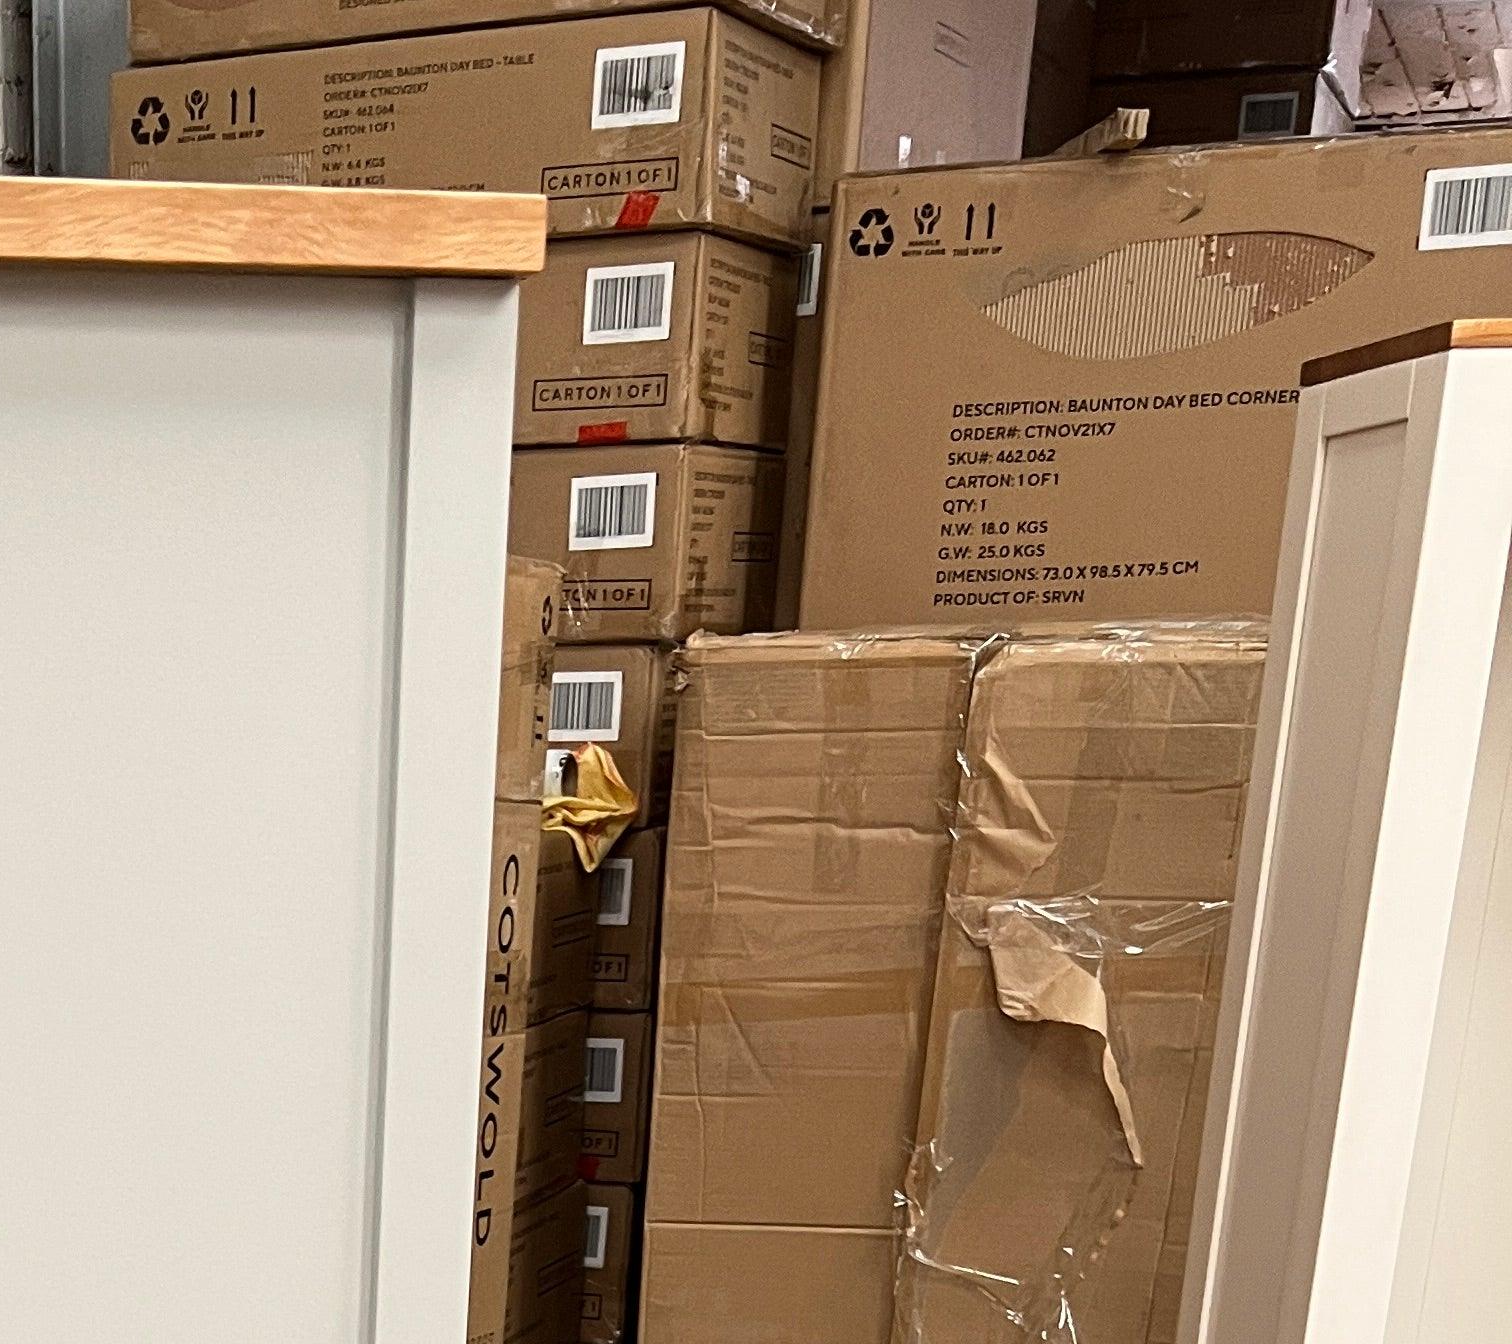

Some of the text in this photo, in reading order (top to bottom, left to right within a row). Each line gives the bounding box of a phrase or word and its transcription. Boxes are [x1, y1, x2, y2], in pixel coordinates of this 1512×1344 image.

[396, 61, 448, 77] BAUNTON
[449, 59, 471, 72] DAY
[472, 57, 494, 70] BED
[503, 53, 535, 66] TABLE
[374, 122, 389, 133] OF
[365, 156, 386, 170] KGS
[547, 166, 672, 191] CARTON 1 OF 1
[539, 382, 661, 401] CARTON 1 OF 1
[953, 390, 1300, 418] DESCRIPTION: BAUNTON DAY BED CORNER
[950, 422, 1116, 441] ORDER#: CTNOV21X7
[948, 449, 1056, 466] SKU#: 462.062
[945, 473, 1059, 489] CARTON: 1 OF 1
[943, 499, 987, 515] QTY: 1
[940, 520, 1048, 537] N.W: 18.0 KGS
[938, 544, 1045, 560] G.W: 25.0 KGS
[936, 561, 1199, 583] DIMENSIONS: 73.0 X 98.5 X 79.5 CM
[563, 588, 645, 601] TON 1 OF 1
[933, 589, 1085, 606] PRODUCT OF: SRVN
[592, 961, 614, 974] OF
[475, 853, 520, 1247] COTSWOLD
